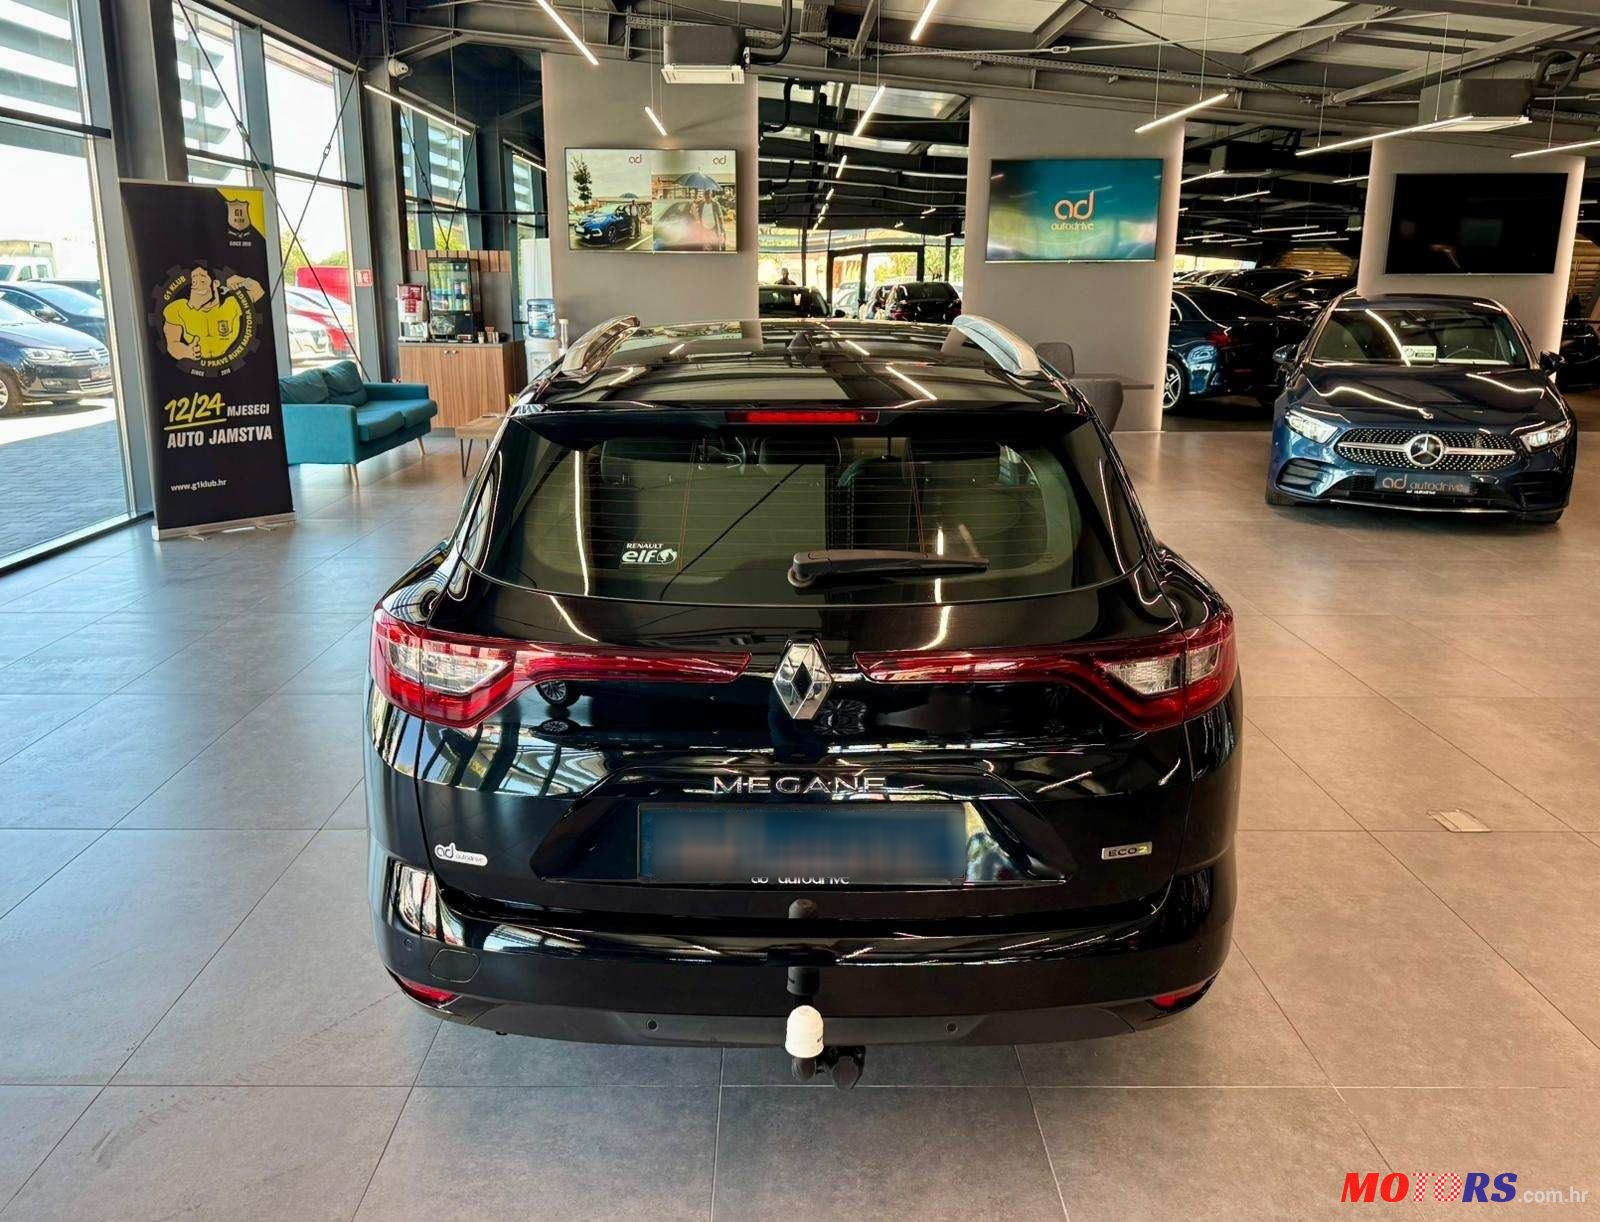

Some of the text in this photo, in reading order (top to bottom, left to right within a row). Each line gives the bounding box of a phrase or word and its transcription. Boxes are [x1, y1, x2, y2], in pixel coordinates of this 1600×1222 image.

[712, 155, 727, 165] ad
[1054, 189, 1095, 220] ad
[1050, 221, 1095, 231] autodrive
[163, 275, 186, 300] G1 KLUB
[164, 392, 270, 422] 12/24 MJESECI
[167, 425, 273, 449] AUTO JAMSTVA
[170, 479, 227, 491] www.g1klub.hr
[1382, 473, 1465, 493] ad autodrive
[621, 549, 658, 563] elf
[713, 776, 887, 794] MEGANE
[436, 844, 454, 859] ad
